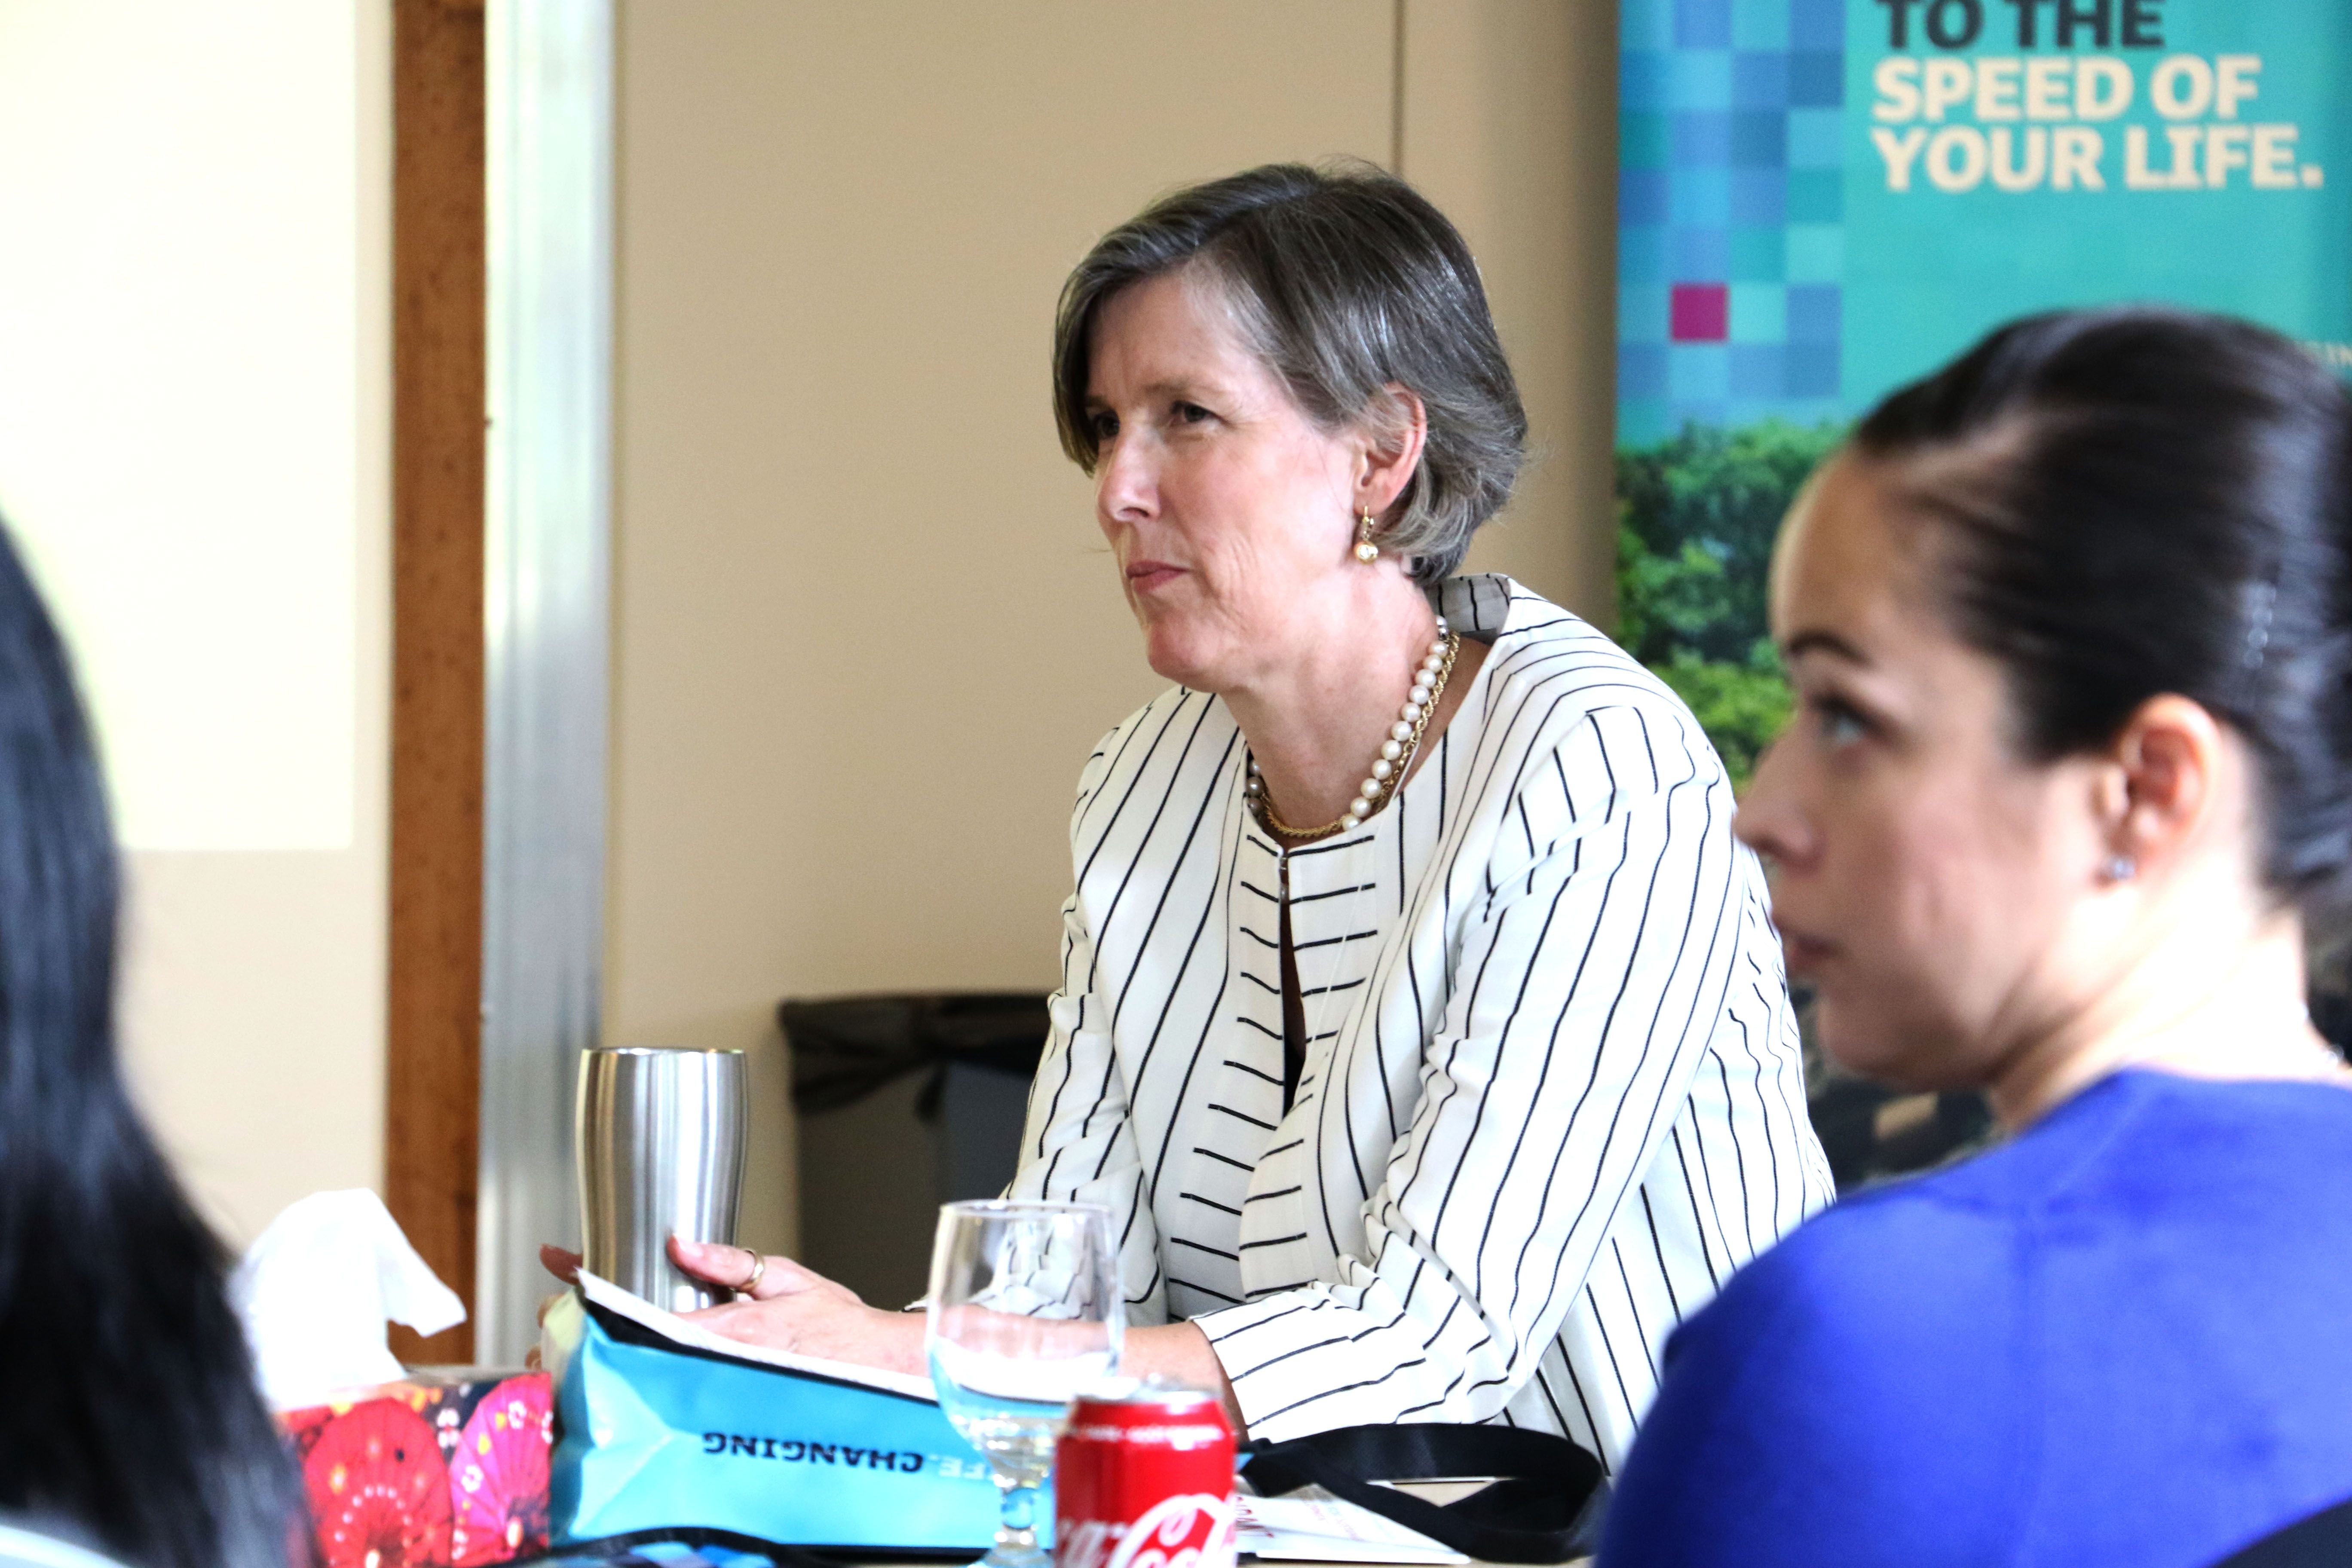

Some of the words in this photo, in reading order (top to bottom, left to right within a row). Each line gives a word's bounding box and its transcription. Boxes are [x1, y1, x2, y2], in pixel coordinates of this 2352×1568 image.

[1875, 0, 1984, 49] TO
[2004, 0, 2165, 49] THE
[1872, 56, 2135, 122] SPEED
[2150, 54, 2262, 120] OF
[1871, 126, 2105, 193] YOUR
[2125, 124, 2324, 189] LIFE.
[702, 1432, 923, 1473] CHANGING
[928, 1454, 994, 1480] FE.
